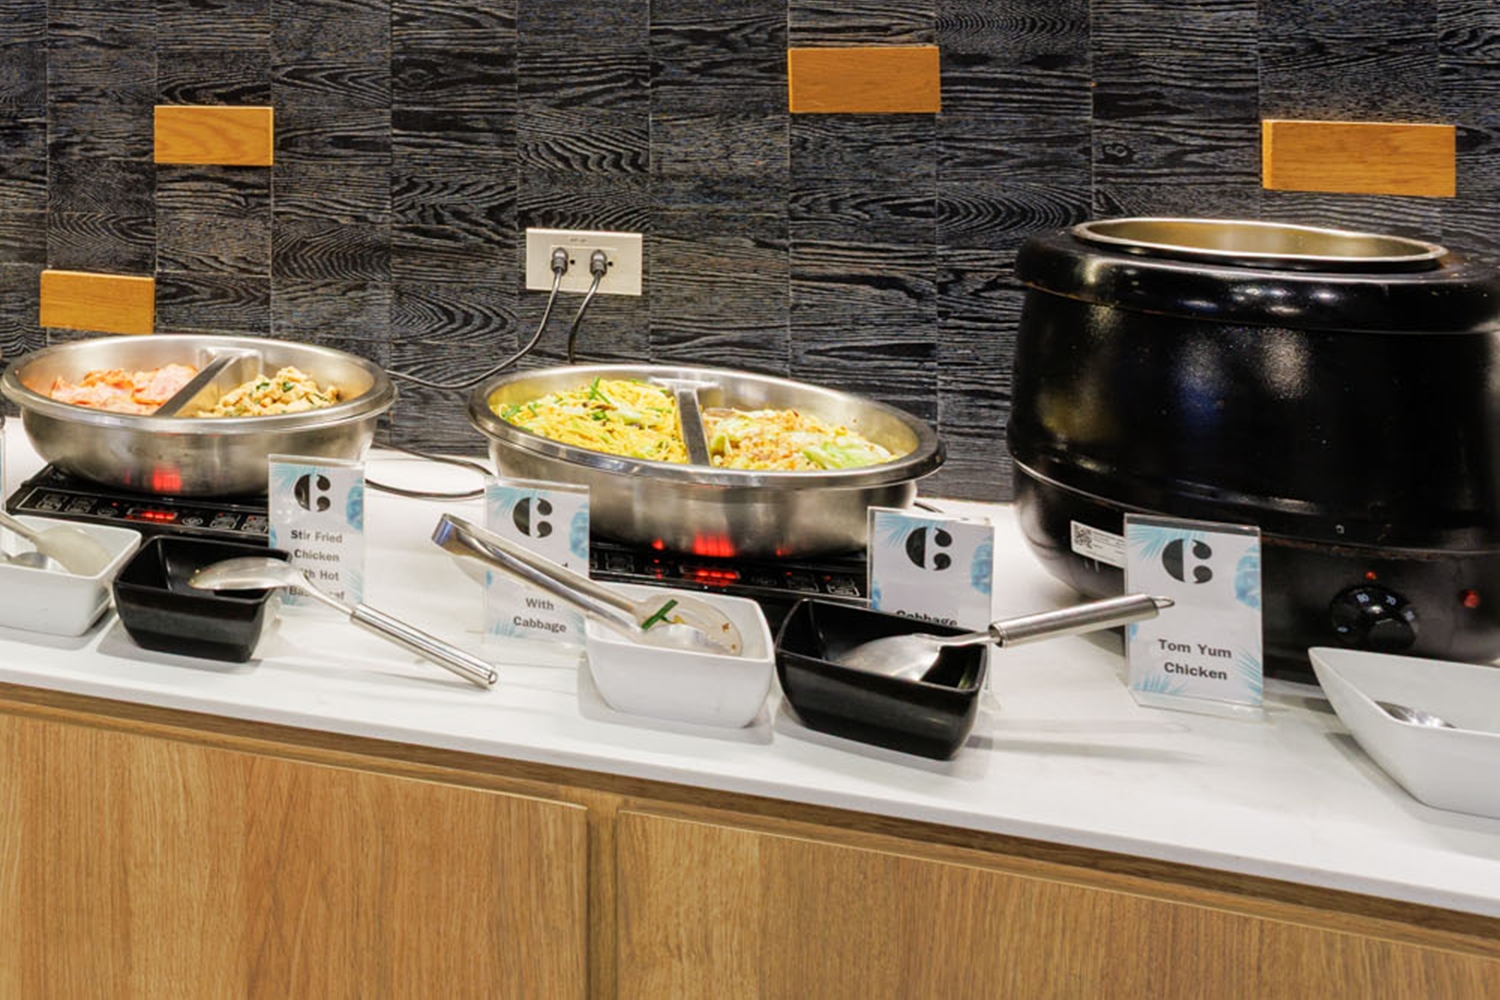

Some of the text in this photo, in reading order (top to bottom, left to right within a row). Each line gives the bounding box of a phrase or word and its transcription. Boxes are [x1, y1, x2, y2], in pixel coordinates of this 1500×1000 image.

[290, 529, 343, 544] Stir Fried
[294, 548, 340, 562] Chicken
[320, 570, 340, 581] Hot
[525, 597, 555, 611] With
[513, 615, 567, 633] Cabbage
[1158, 638, 1232, 659] Tom Yum
[1164, 661, 1228, 681] Chicken
